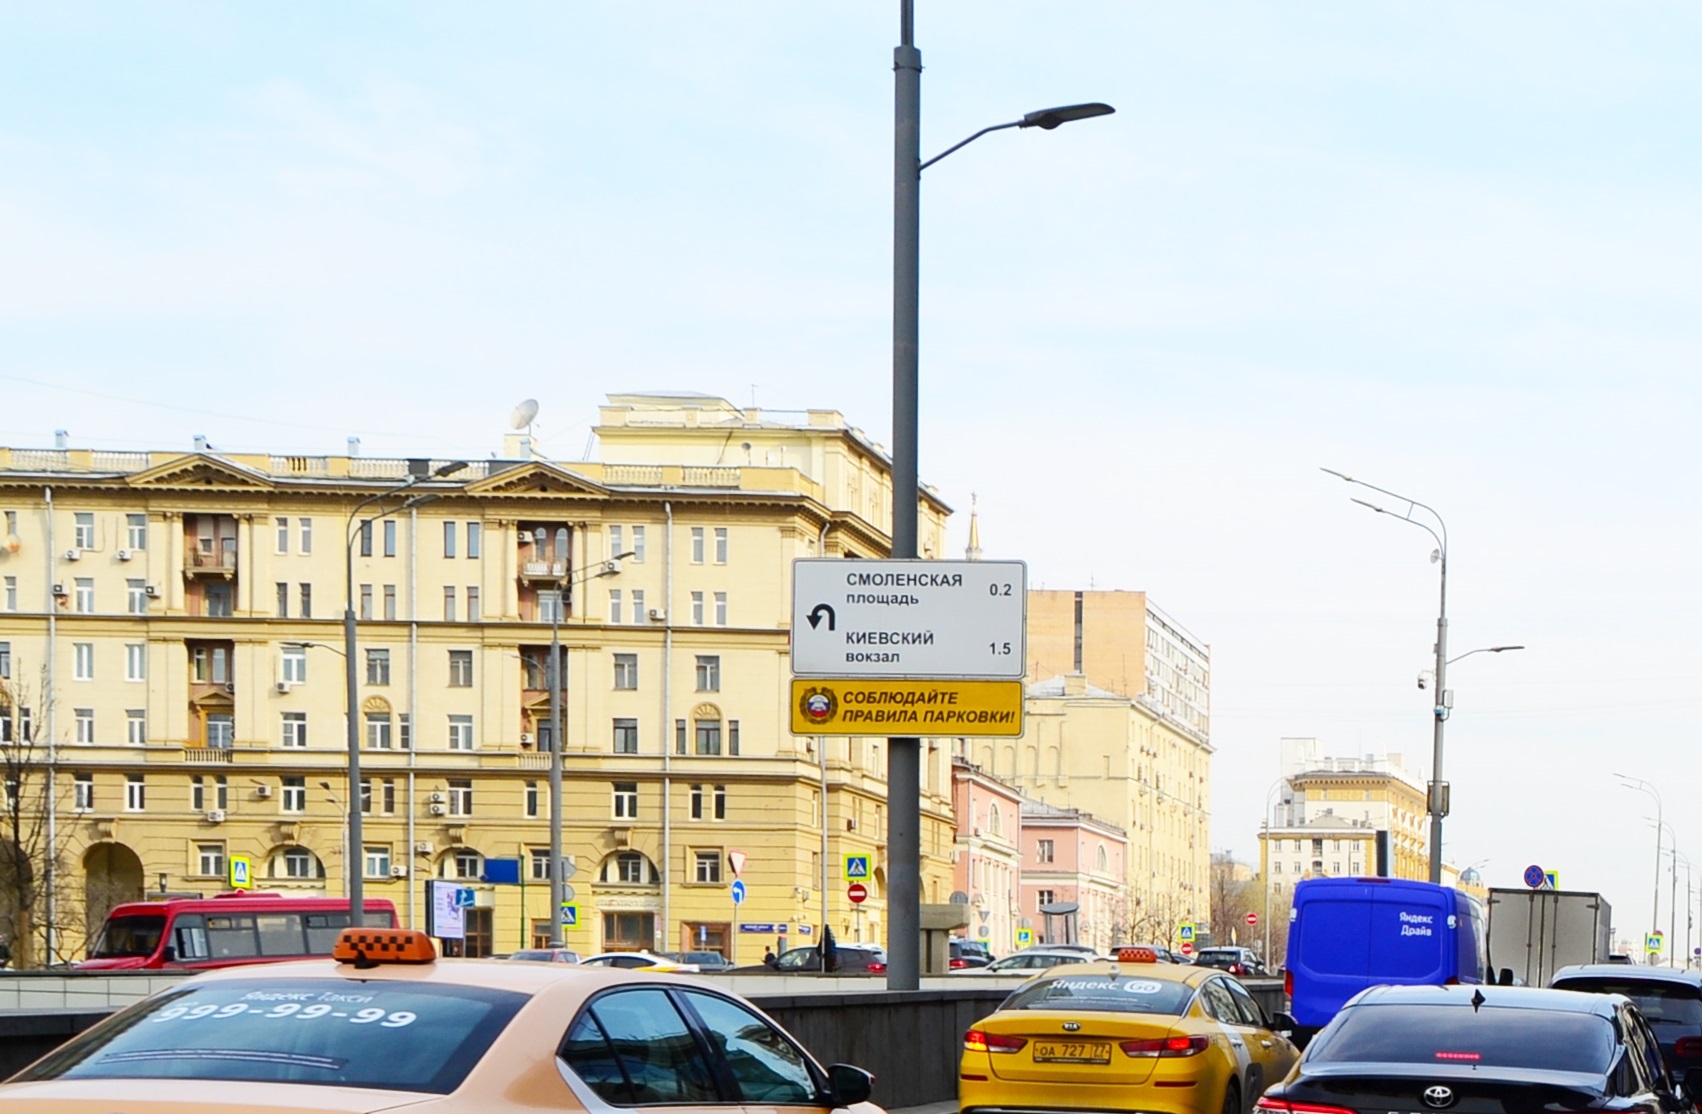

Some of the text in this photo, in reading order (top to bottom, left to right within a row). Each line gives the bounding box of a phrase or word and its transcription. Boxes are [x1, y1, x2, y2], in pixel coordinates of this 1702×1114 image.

[846, 573, 963, 587] СМОЛЕНСКАЯ
[989, 583, 1012, 596] 0.2
[846, 593, 919, 606] площадь
[846, 630, 934, 645] КИЕВСКИЙ
[989, 642, 1011, 655] 1.5
[845, 652, 900, 663] вокзал
[842, 690, 959, 706] СОБЛЮДАЙТЕ
[842, 710, 1015, 724] ПРАВИЛА ПАРКОВКИ!
[1399, 911, 1433, 924] Яндекс
[1400, 925, 1432, 936] Драйв
[1048, 979, 1120, 990] Яндекс
[152, 1002, 417, 1028] 999-99-99
[1062, 1044, 1086, 1057] 727
